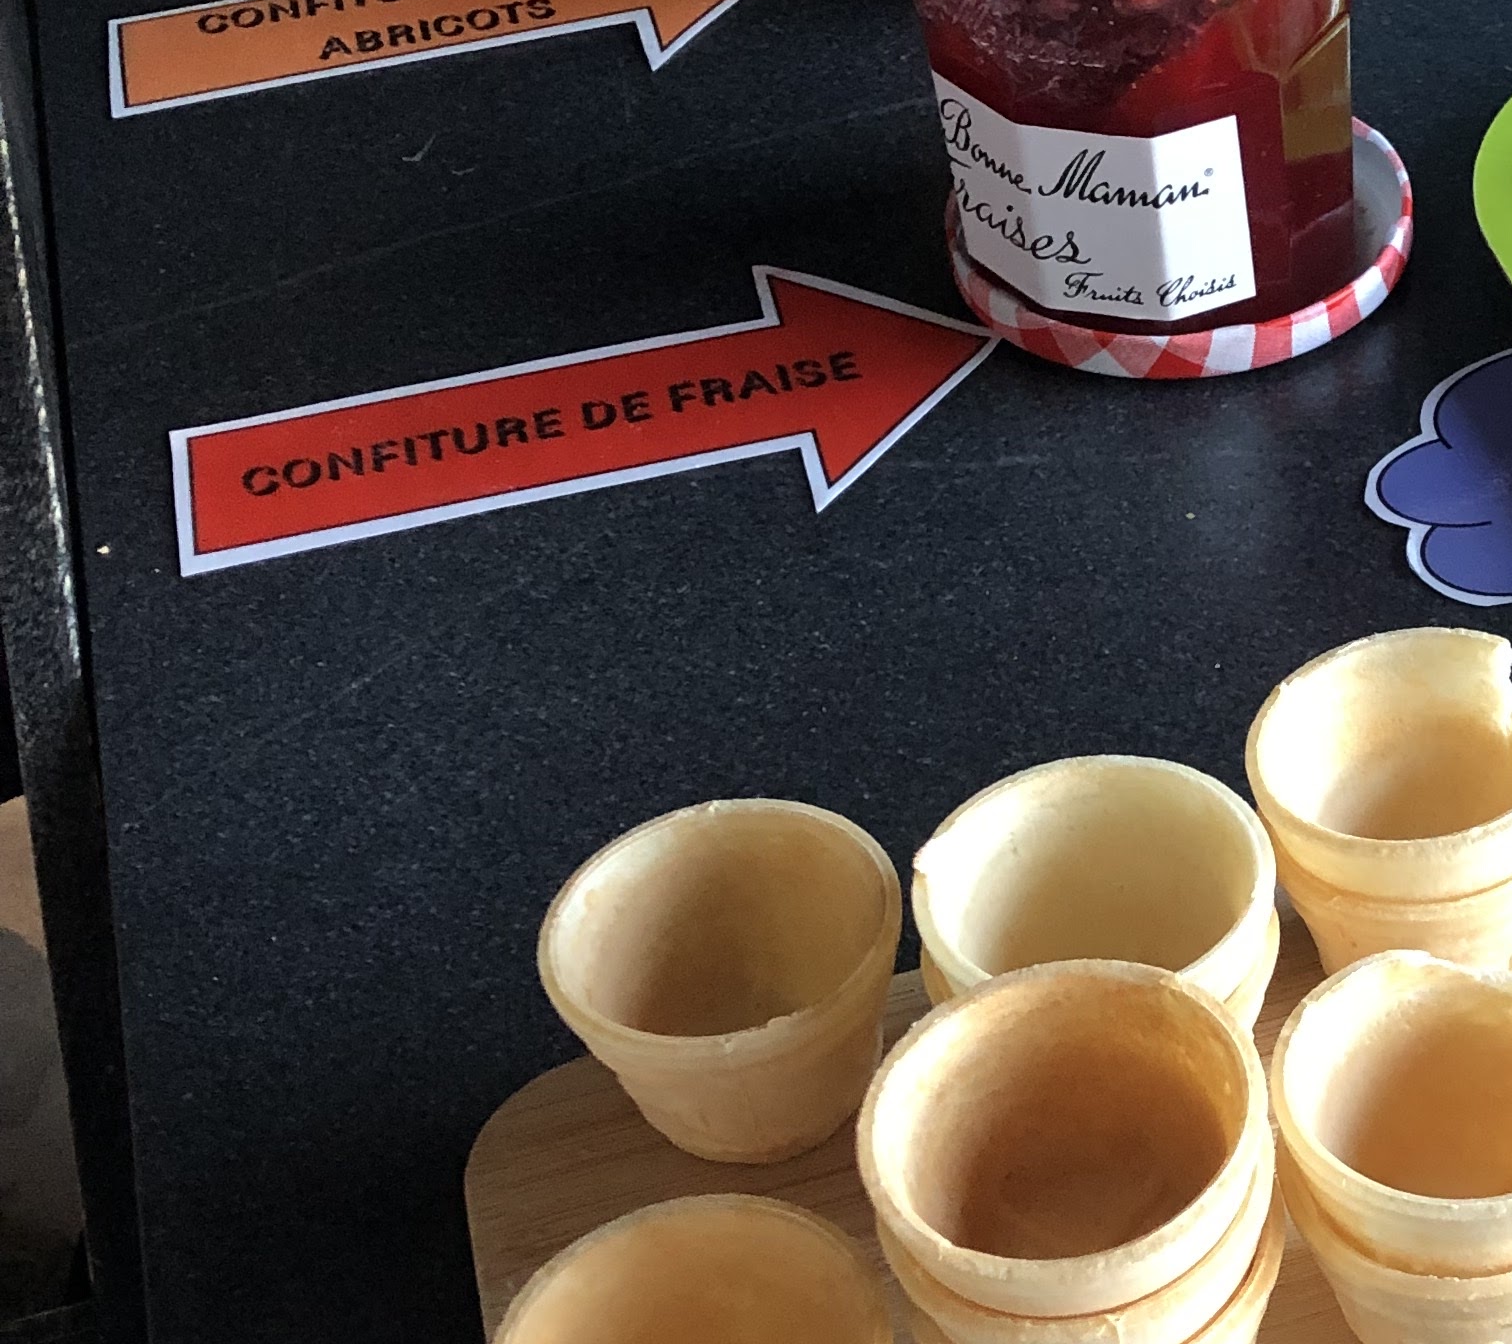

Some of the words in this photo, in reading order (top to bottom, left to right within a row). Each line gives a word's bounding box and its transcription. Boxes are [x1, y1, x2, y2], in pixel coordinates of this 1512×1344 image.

[940, 98, 1032, 195] Bonne
[1063, 271, 1145, 306] Fruits
[1155, 273, 1237, 308] Choisis
[241, 407, 565, 498] CONFITURE
[580, 390, 653, 431] DE
[667, 351, 863, 414] FRAISE
